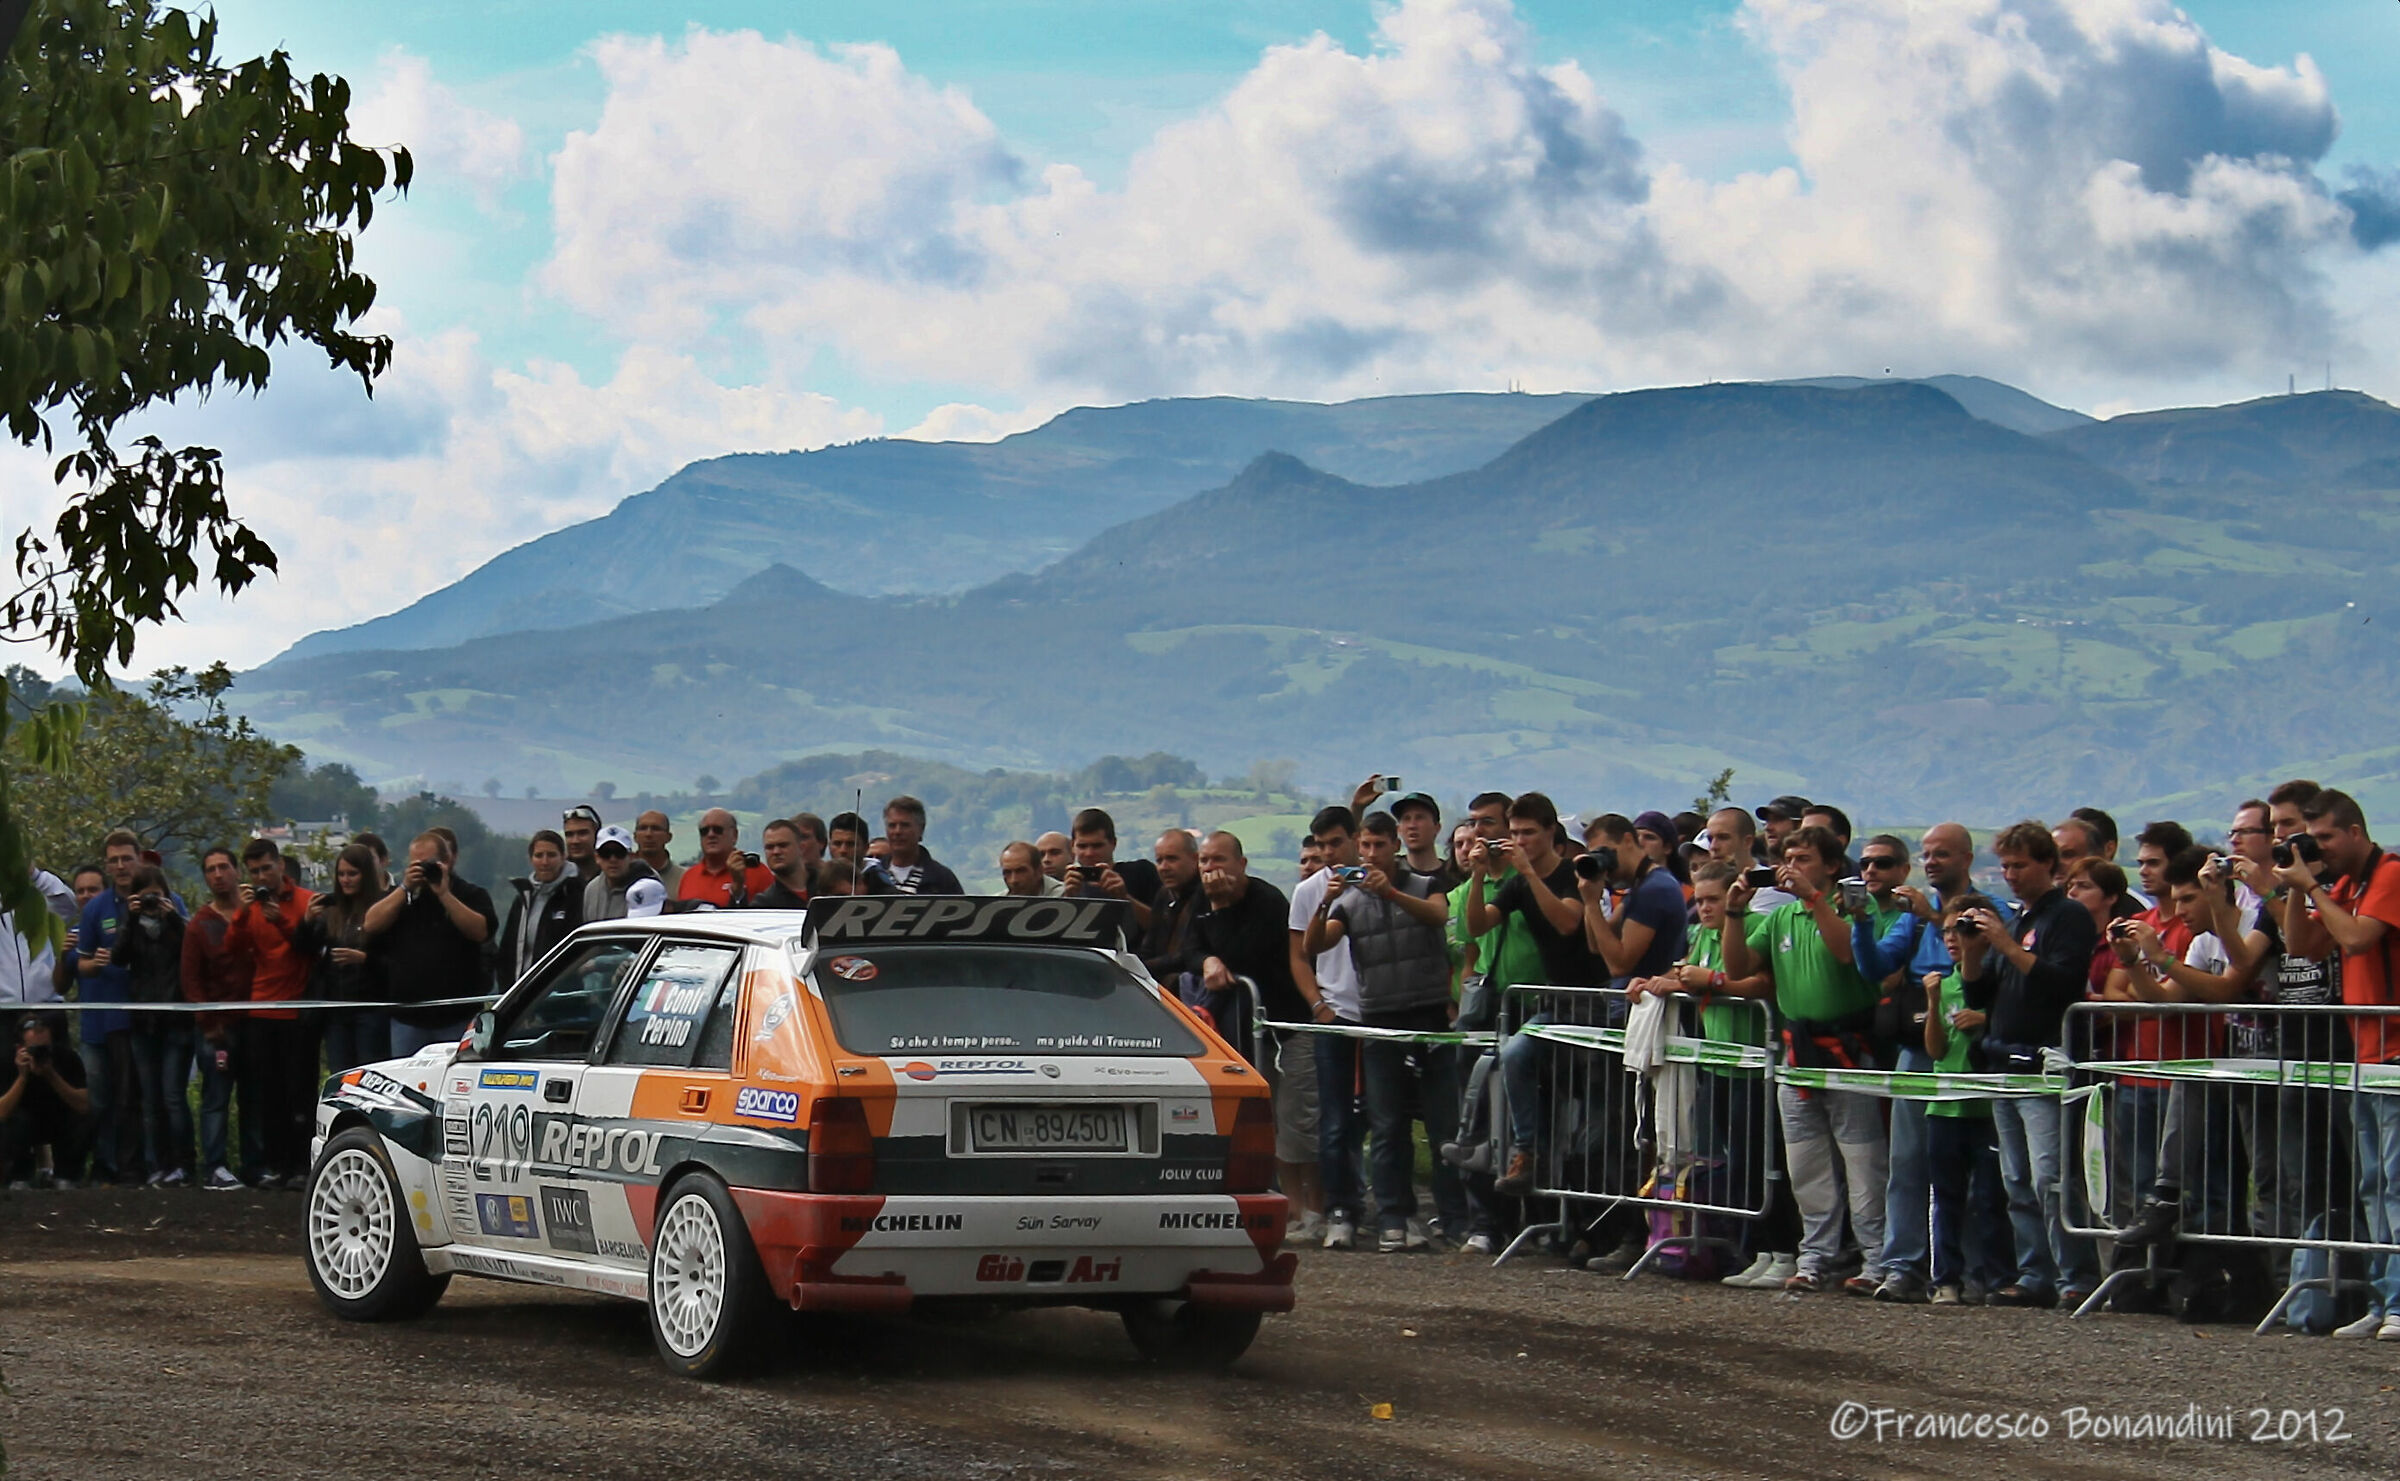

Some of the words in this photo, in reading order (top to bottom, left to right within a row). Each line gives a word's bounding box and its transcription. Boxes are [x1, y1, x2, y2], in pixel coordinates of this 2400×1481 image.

[819, 900, 1105, 938] REPSOL
[640, 1014, 692, 1047] Perino
[908, 1036, 928, 1047] che
[942, 1036, 978, 1048] tempo
[1036, 1036, 1054, 1046] ma
[1058, 1035, 1088, 1048] guido
[1091, 1035, 1103, 1047] di
[940, 1060, 1026, 1069] REPSOL
[360, 1071, 404, 1099] REPSOL
[738, 1088, 798, 1114] sparco
[980, 1113, 1018, 1142] CN
[1035, 1113, 1121, 1142] 894501
[474, 1102, 531, 1184] 219
[540, 1120, 663, 1175] REPSOL
[1158, 1169, 1192, 1180] JOLLY
[1196, 1169, 1223, 1180] CLUB
[552, 1196, 585, 1226] IWC
[841, 1214, 962, 1232] MICHELIN
[1050, 1215, 1102, 1231] Sarvay
[1159, 1213, 1274, 1229] MICHELIN
[976, 1254, 1025, 1282] Giò
[1067, 1256, 1121, 1283] Ari
